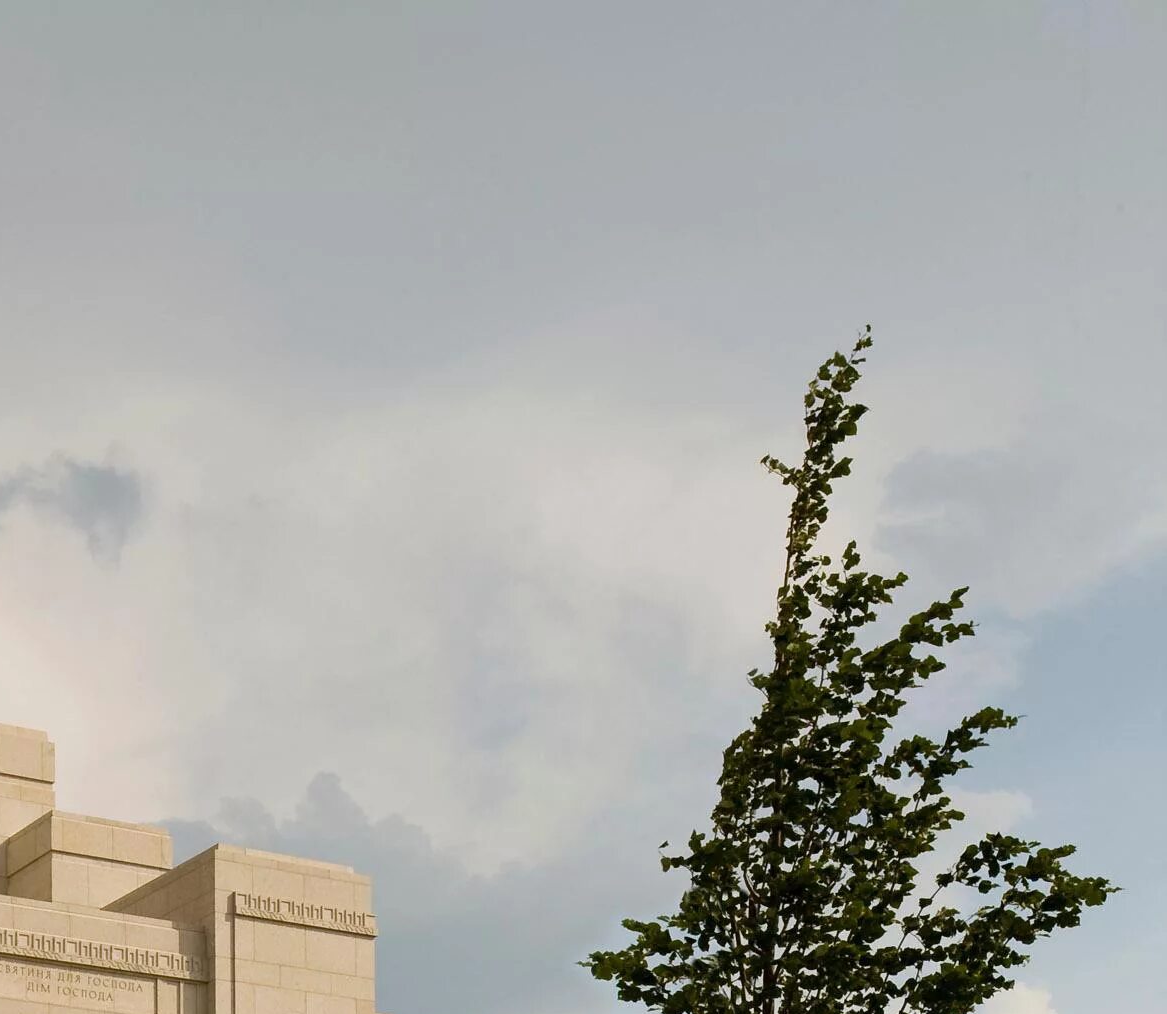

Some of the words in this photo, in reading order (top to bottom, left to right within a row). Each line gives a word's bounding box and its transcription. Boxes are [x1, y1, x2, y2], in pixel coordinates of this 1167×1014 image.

[26, 981, 50, 993] ДІМ
[57, 986, 114, 1001] ГОСПОДА
[57, 971, 81, 984] ДЛЯ
[87, 975, 143, 993] ГОСПОДА
